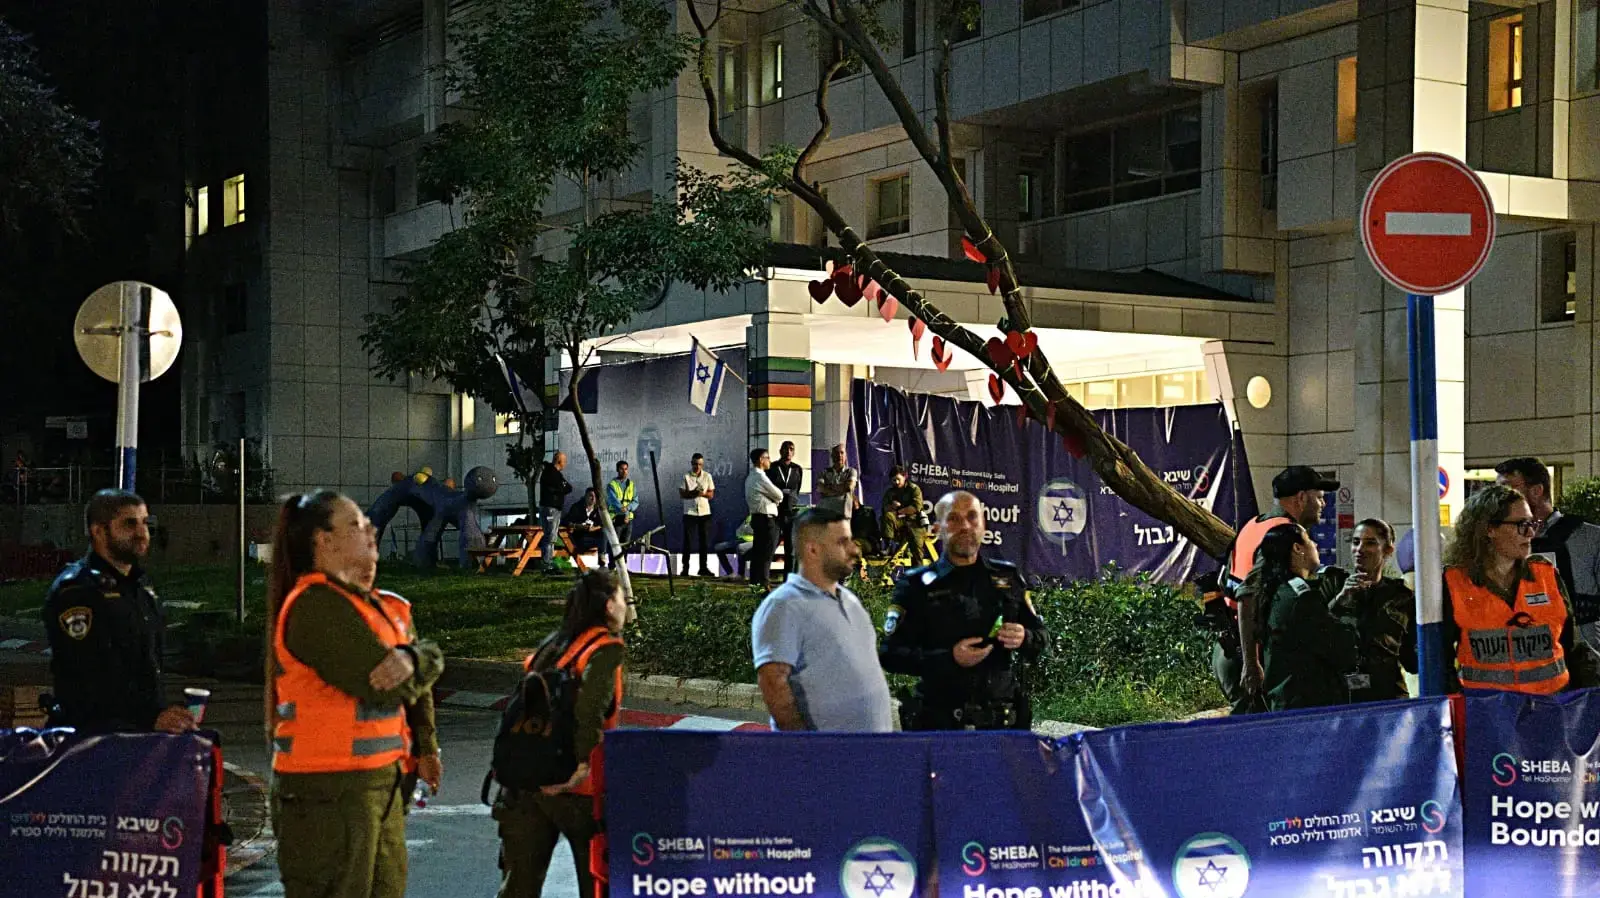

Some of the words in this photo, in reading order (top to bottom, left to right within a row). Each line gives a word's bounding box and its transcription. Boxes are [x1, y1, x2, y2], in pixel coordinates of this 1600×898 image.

[911, 463, 949, 477] SHEBA
[1163, 470, 1191, 482] שיבא
[988, 482, 1019, 494] Hospital
[980, 501, 1020, 523] hout
[1134, 524, 1174, 546] גבול
[1470, 634, 1509, 659] העורף
[1512, 633, 1551, 657] פיקוד
[1521, 760, 1571, 773] SHEBA
[1371, 806, 1415, 824] שיבא
[1491, 795, 1572, 824] Hope
[88, 814, 107, 825] בית
[116, 815, 160, 832] שיבא
[1269, 817, 1302, 832] לילדים
[1304, 814, 1340, 828] החולים
[1342, 813, 1360, 824] בית
[1326, 826, 1362, 840] אדמונד
[1371, 823, 1402, 835] השומר
[1404, 822, 1417, 832] תל
[1270, 834, 1300, 846] ספרא
[1302, 829, 1325, 841] ולילי
[1491, 822, 1600, 847] Bounda
[657, 838, 705, 851] SHEBA
[767, 848, 812, 861] Hospital
[989, 846, 1039, 860] SHEBA
[1362, 840, 1449, 871] תקווה
[102, 850, 180, 878] תקווה
[63, 872, 119, 898] גבול
[632, 874, 707, 898] Hope
[713, 872, 816, 896] without
